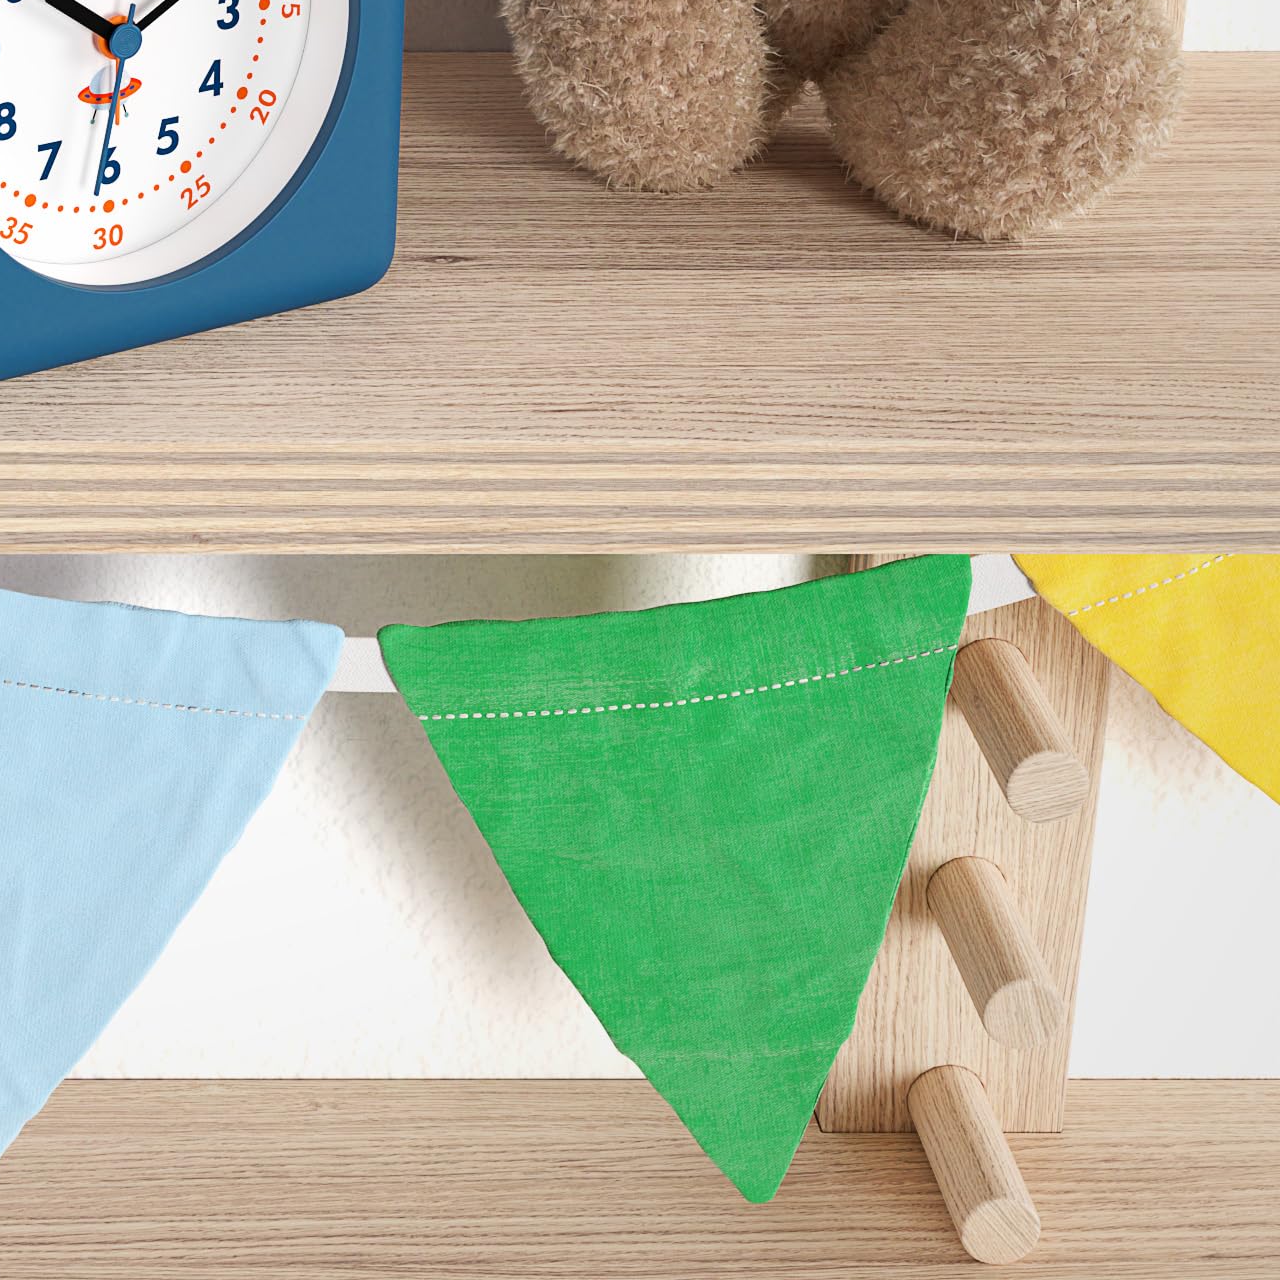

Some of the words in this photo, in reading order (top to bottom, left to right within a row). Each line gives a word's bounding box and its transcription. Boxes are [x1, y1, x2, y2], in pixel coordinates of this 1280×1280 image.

[198, 59, 224, 97] 4
[249, 89, 277, 126] 20
[156, 115, 180, 156] 5
[37, 140, 63, 181] 7
[100, 145, 121, 184] 6
[180, 174, 211, 210] 25
[0, 216, 34, 245] 35
[92, 224, 124, 251] 30
